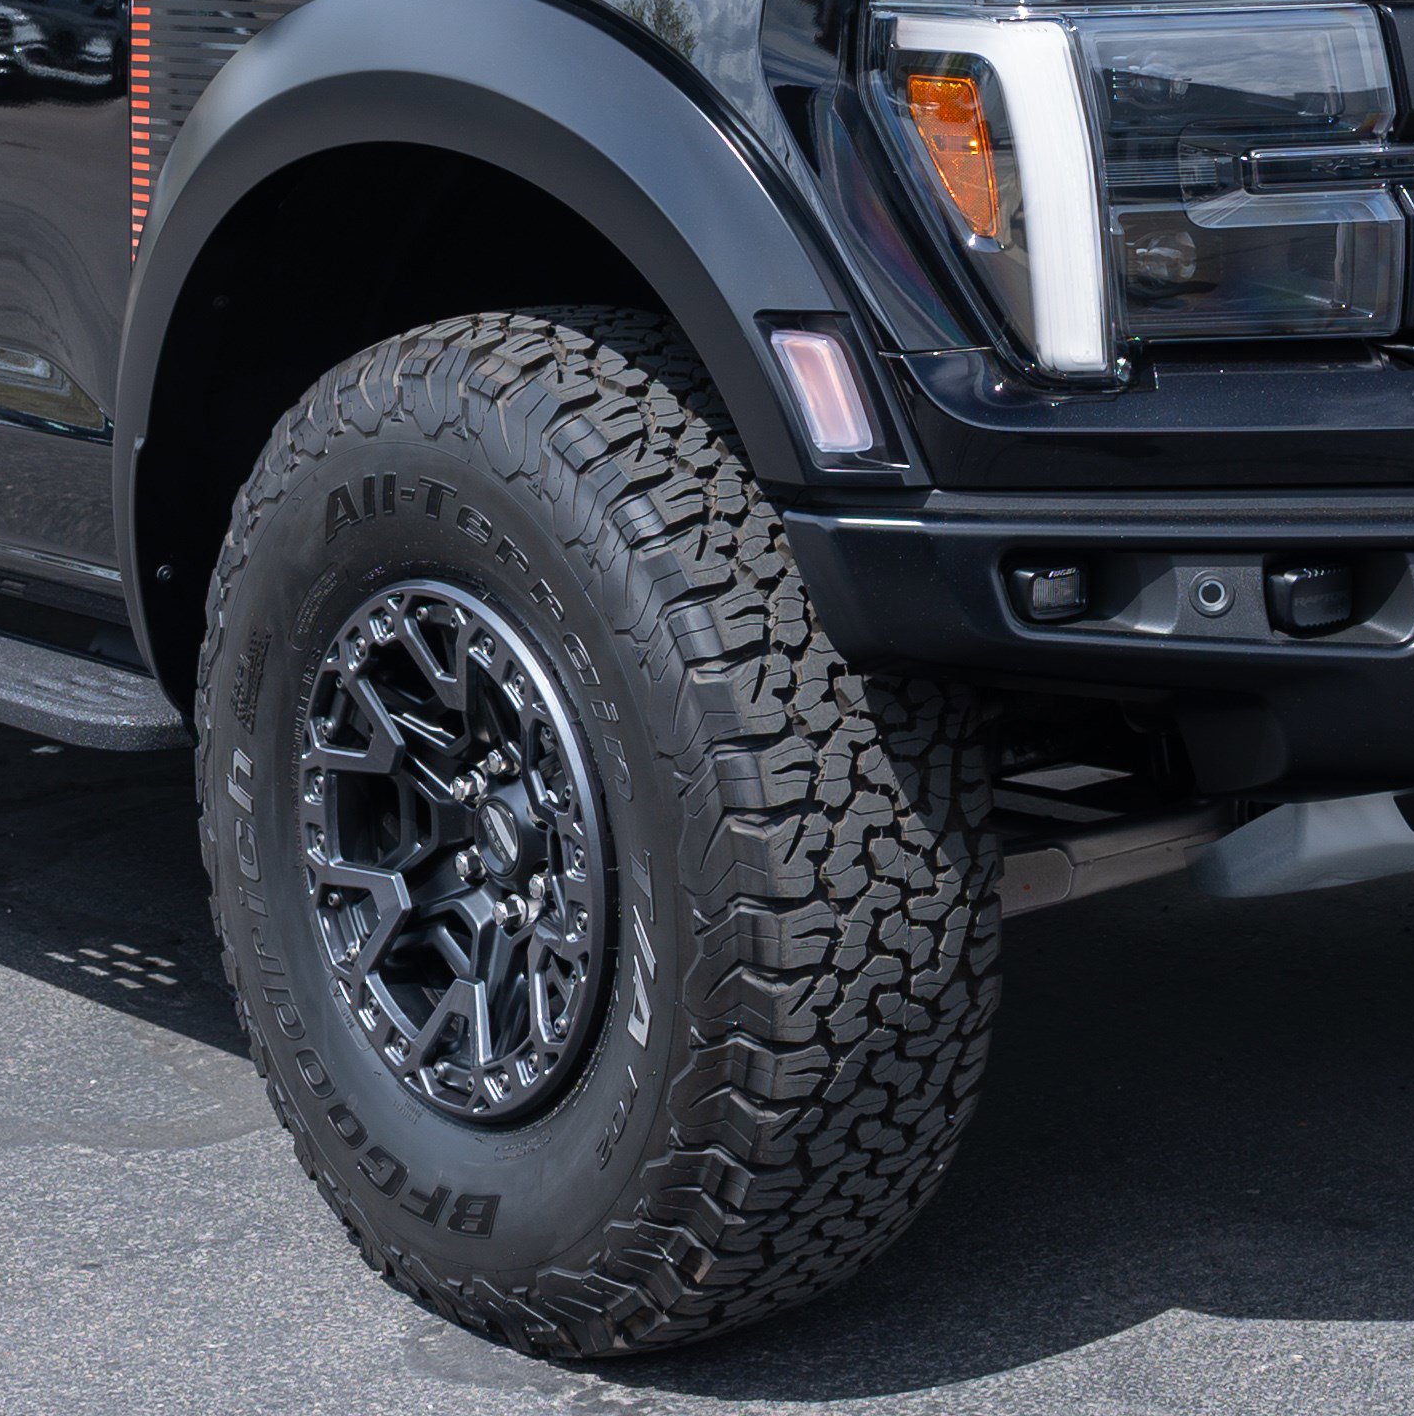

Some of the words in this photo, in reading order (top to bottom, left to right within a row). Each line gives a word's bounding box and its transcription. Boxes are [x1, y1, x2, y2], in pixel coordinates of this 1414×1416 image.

[231, 745, 502, 1239] BFGoodrich
[324, 471, 636, 803] All-Terrain
[628, 849, 658, 1050] T/A
